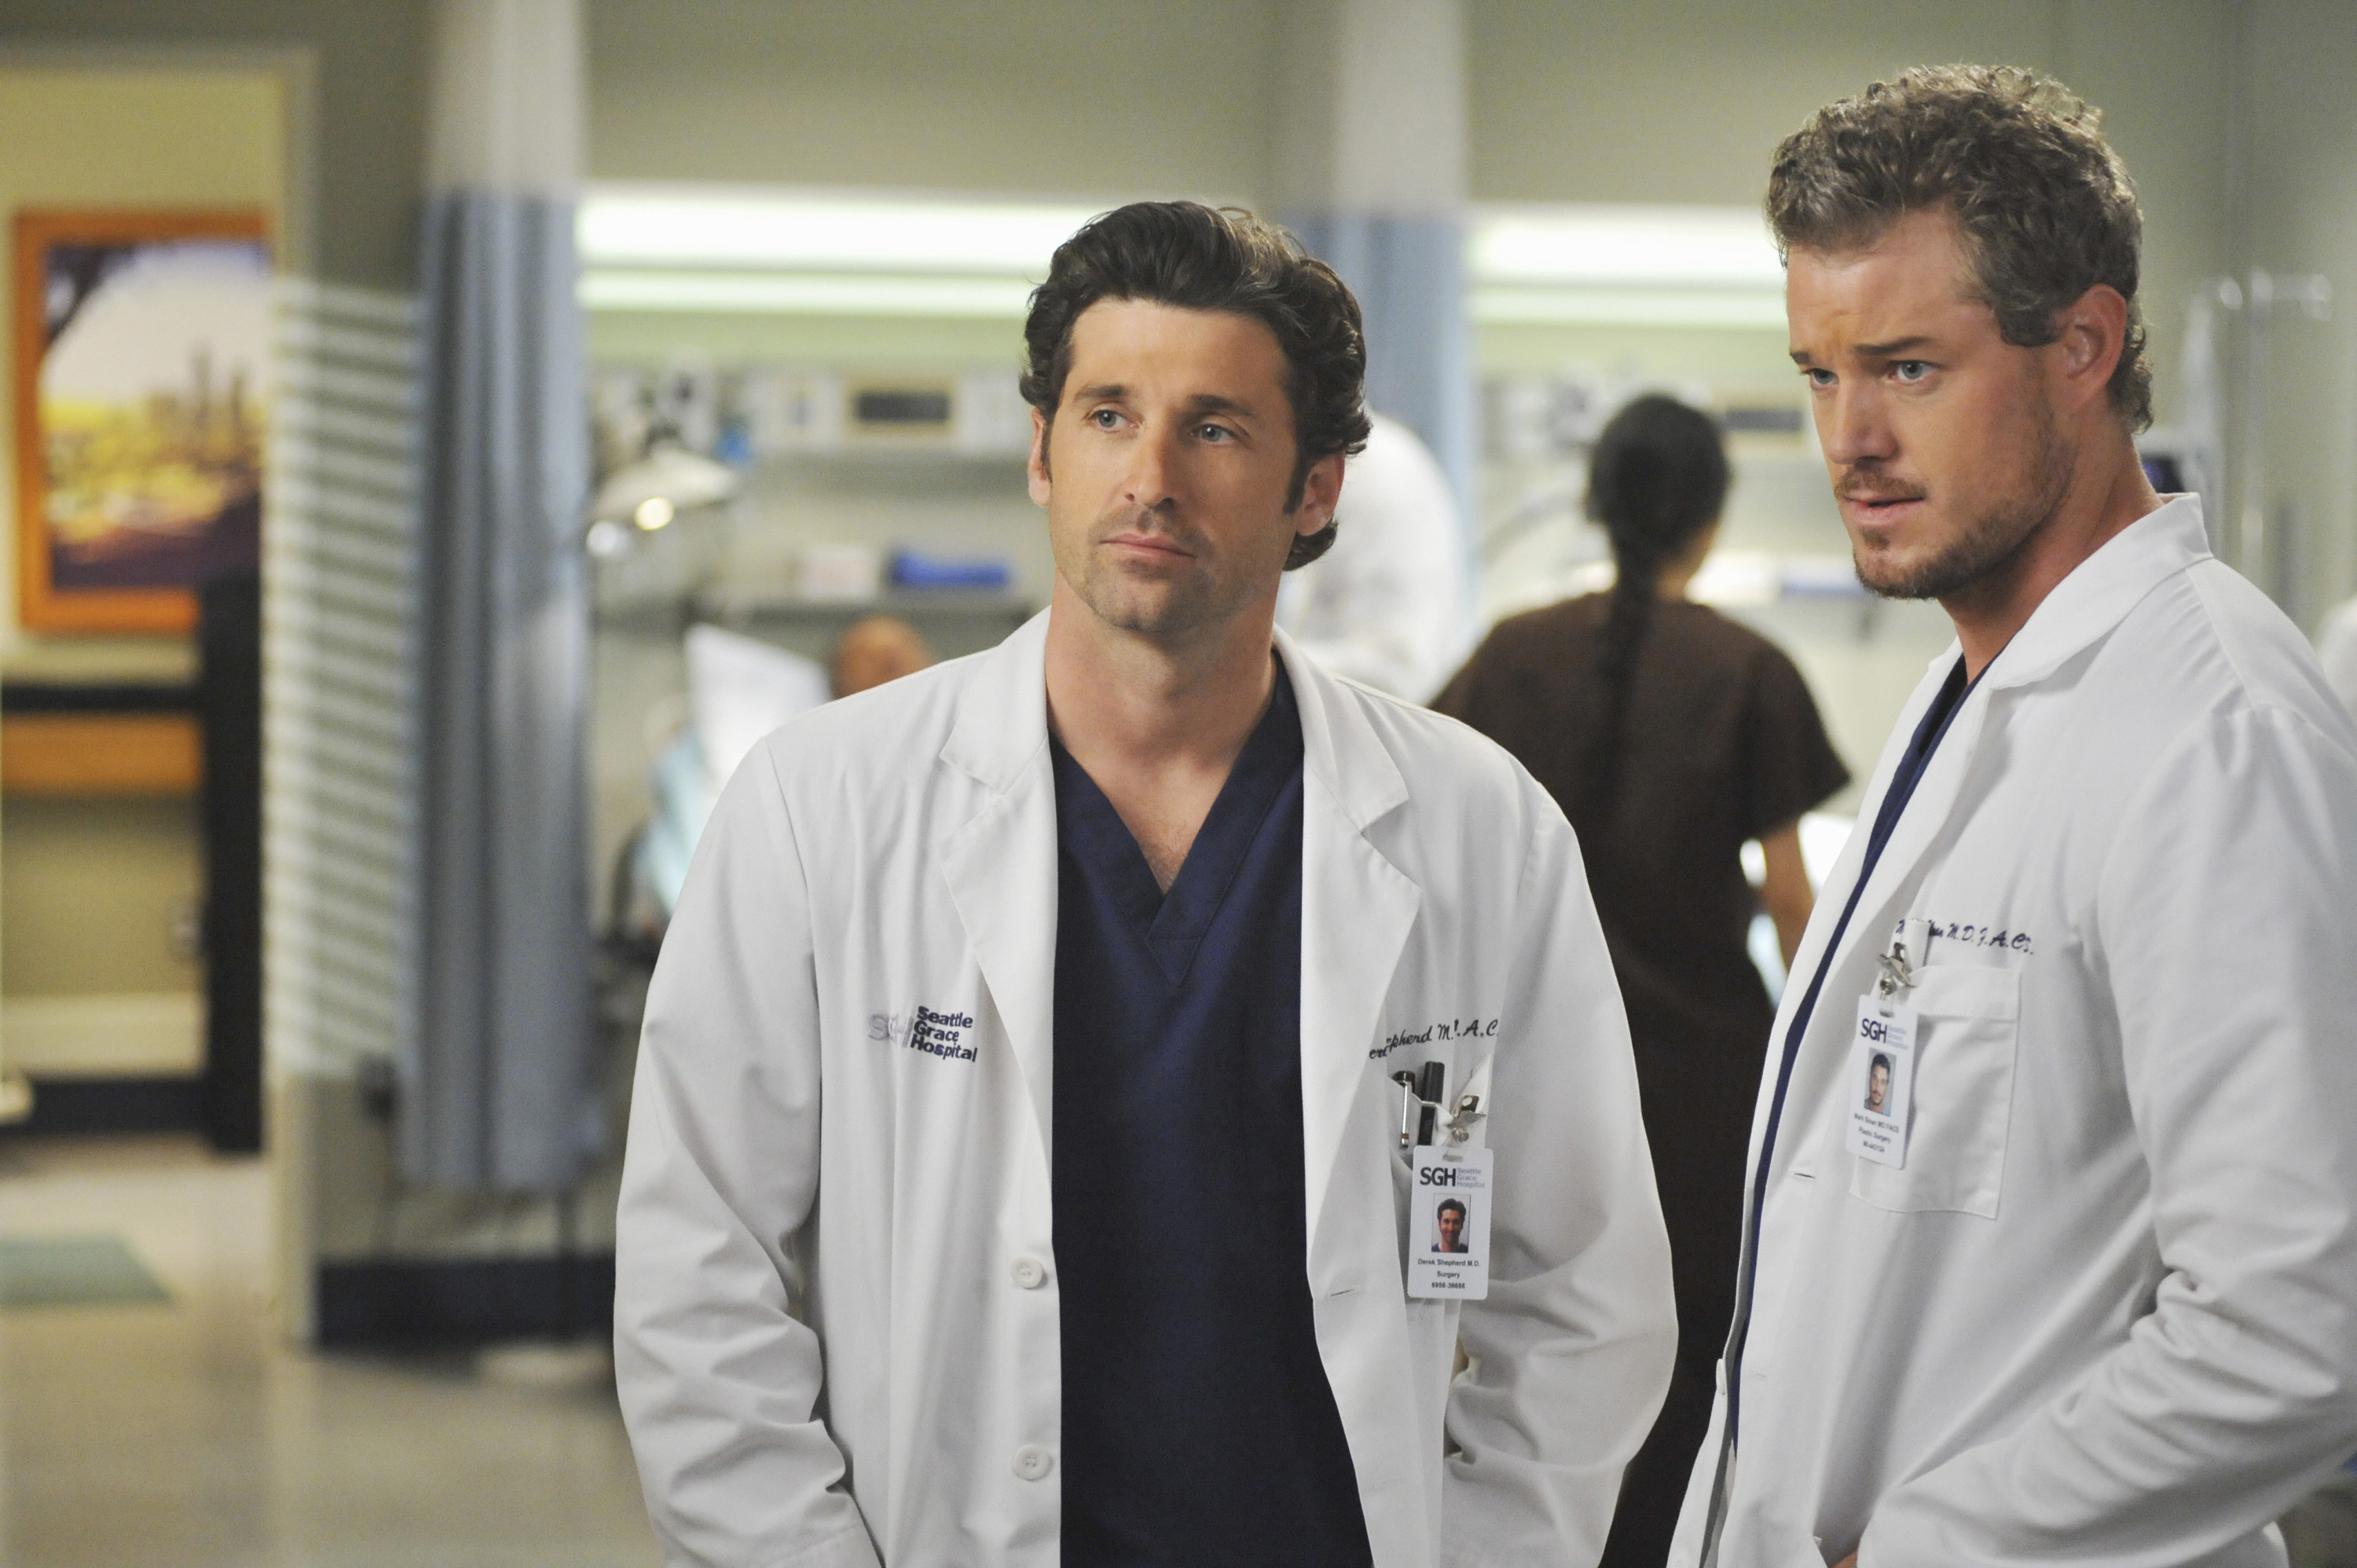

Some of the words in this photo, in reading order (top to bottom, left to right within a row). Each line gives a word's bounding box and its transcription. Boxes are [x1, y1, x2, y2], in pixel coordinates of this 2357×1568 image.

[917, 1006, 973, 1028] Seattle
[914, 1020, 959, 1042] Grace
[1860, 1018, 1887, 1043] SGH
[910, 1034, 978, 1062] Hospital
[1420, 1167, 1457, 1187] SGH
[1437, 1258, 1466, 1267] Shepherd
[1437, 1270, 1461, 1279] Surgery
